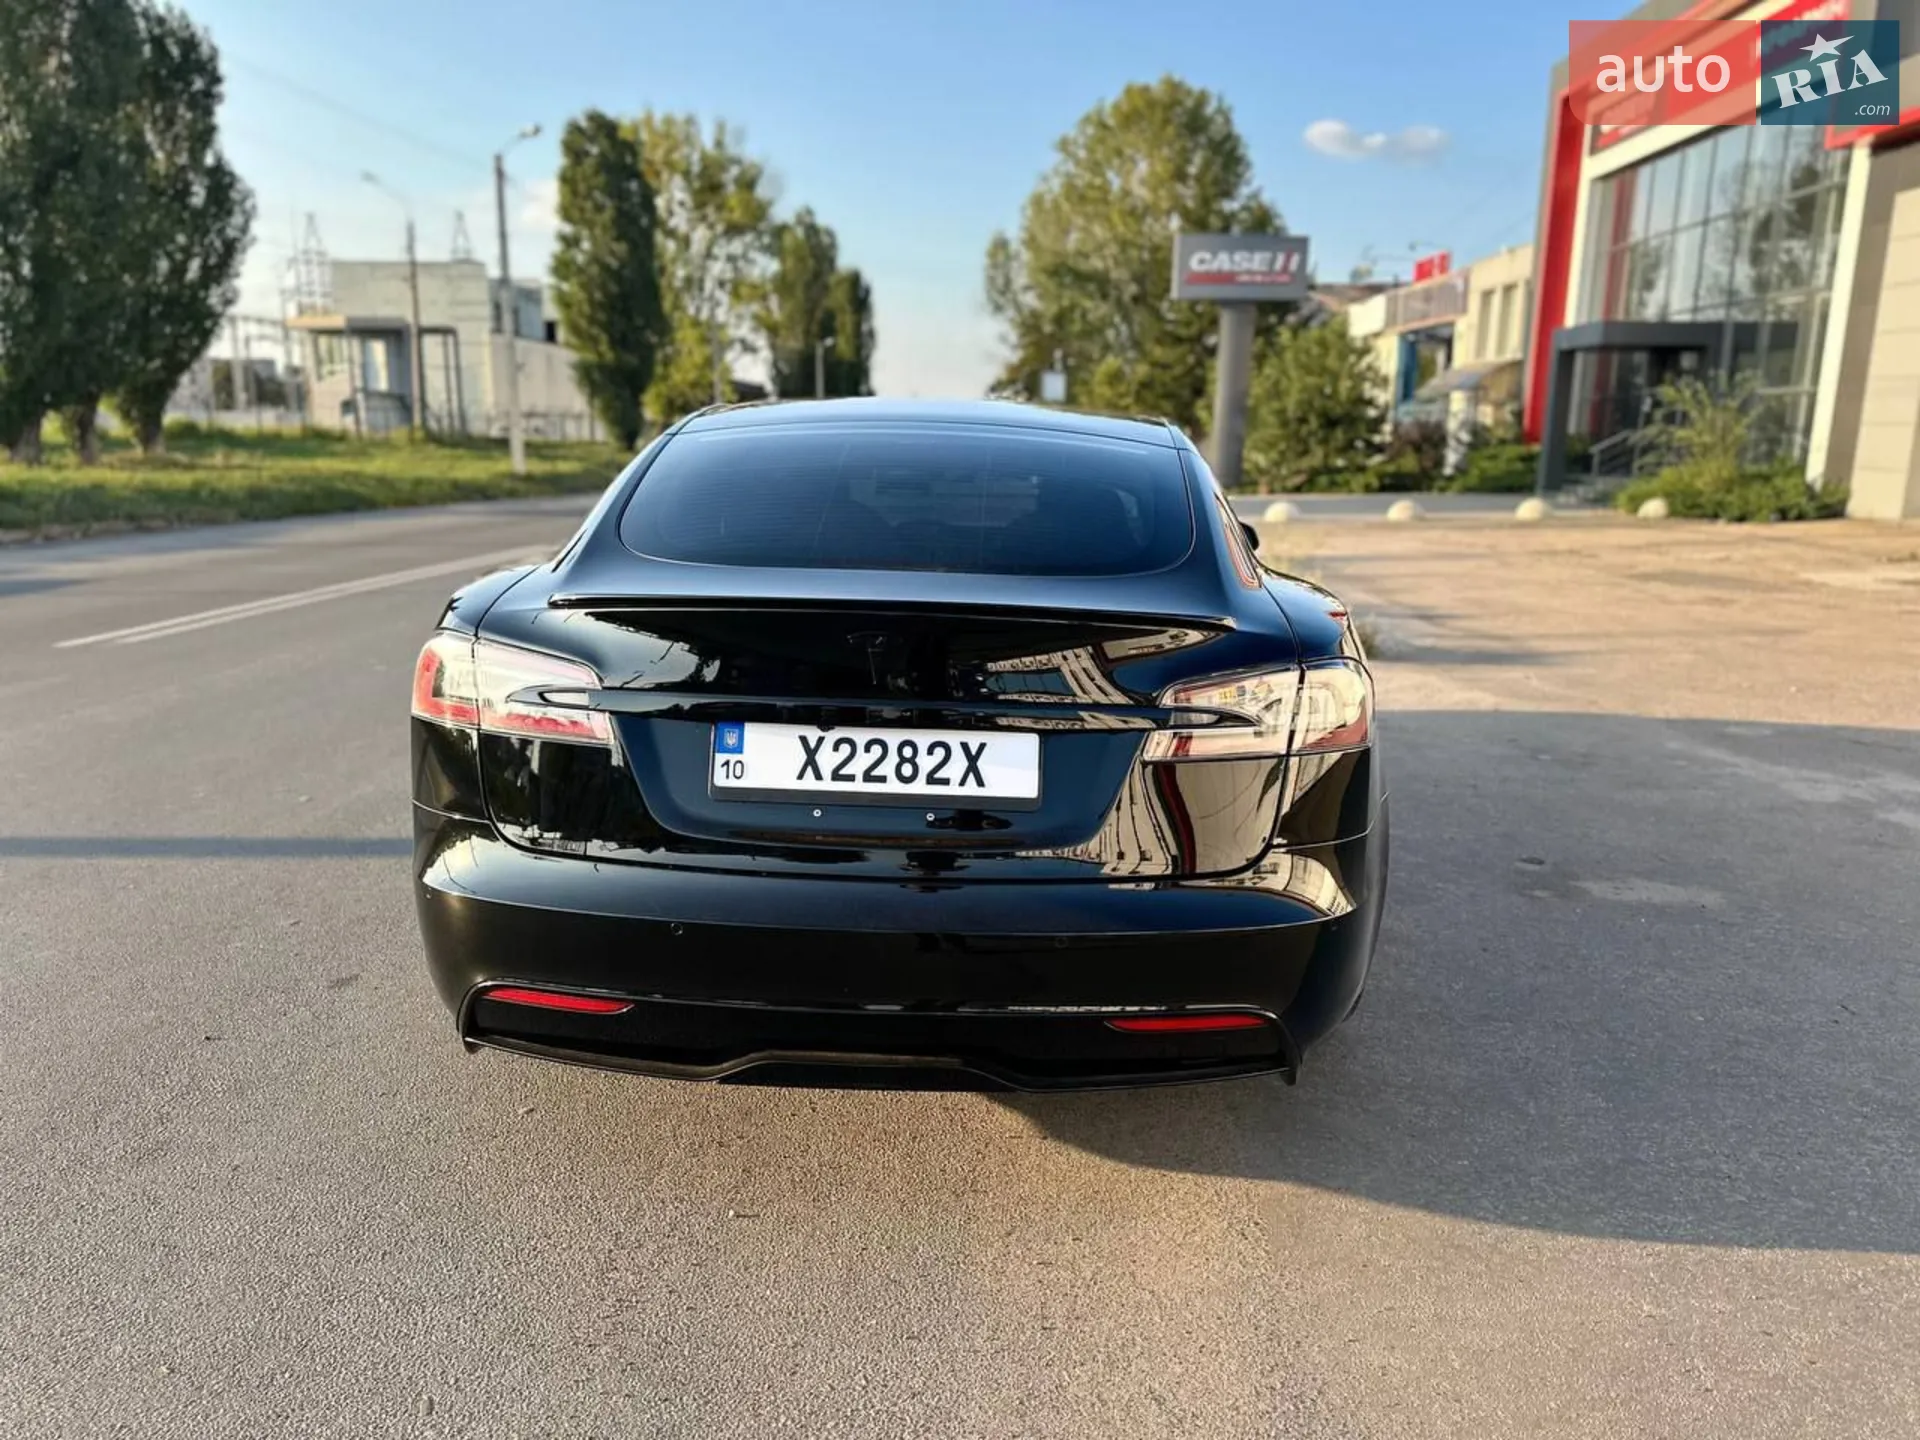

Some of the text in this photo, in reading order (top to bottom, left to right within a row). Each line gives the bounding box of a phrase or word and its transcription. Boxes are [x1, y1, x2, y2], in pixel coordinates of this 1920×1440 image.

[1188, 250, 1272, 273] CASE
[720, 759, 745, 780] 10
[796, 735, 987, 788] X2282X
